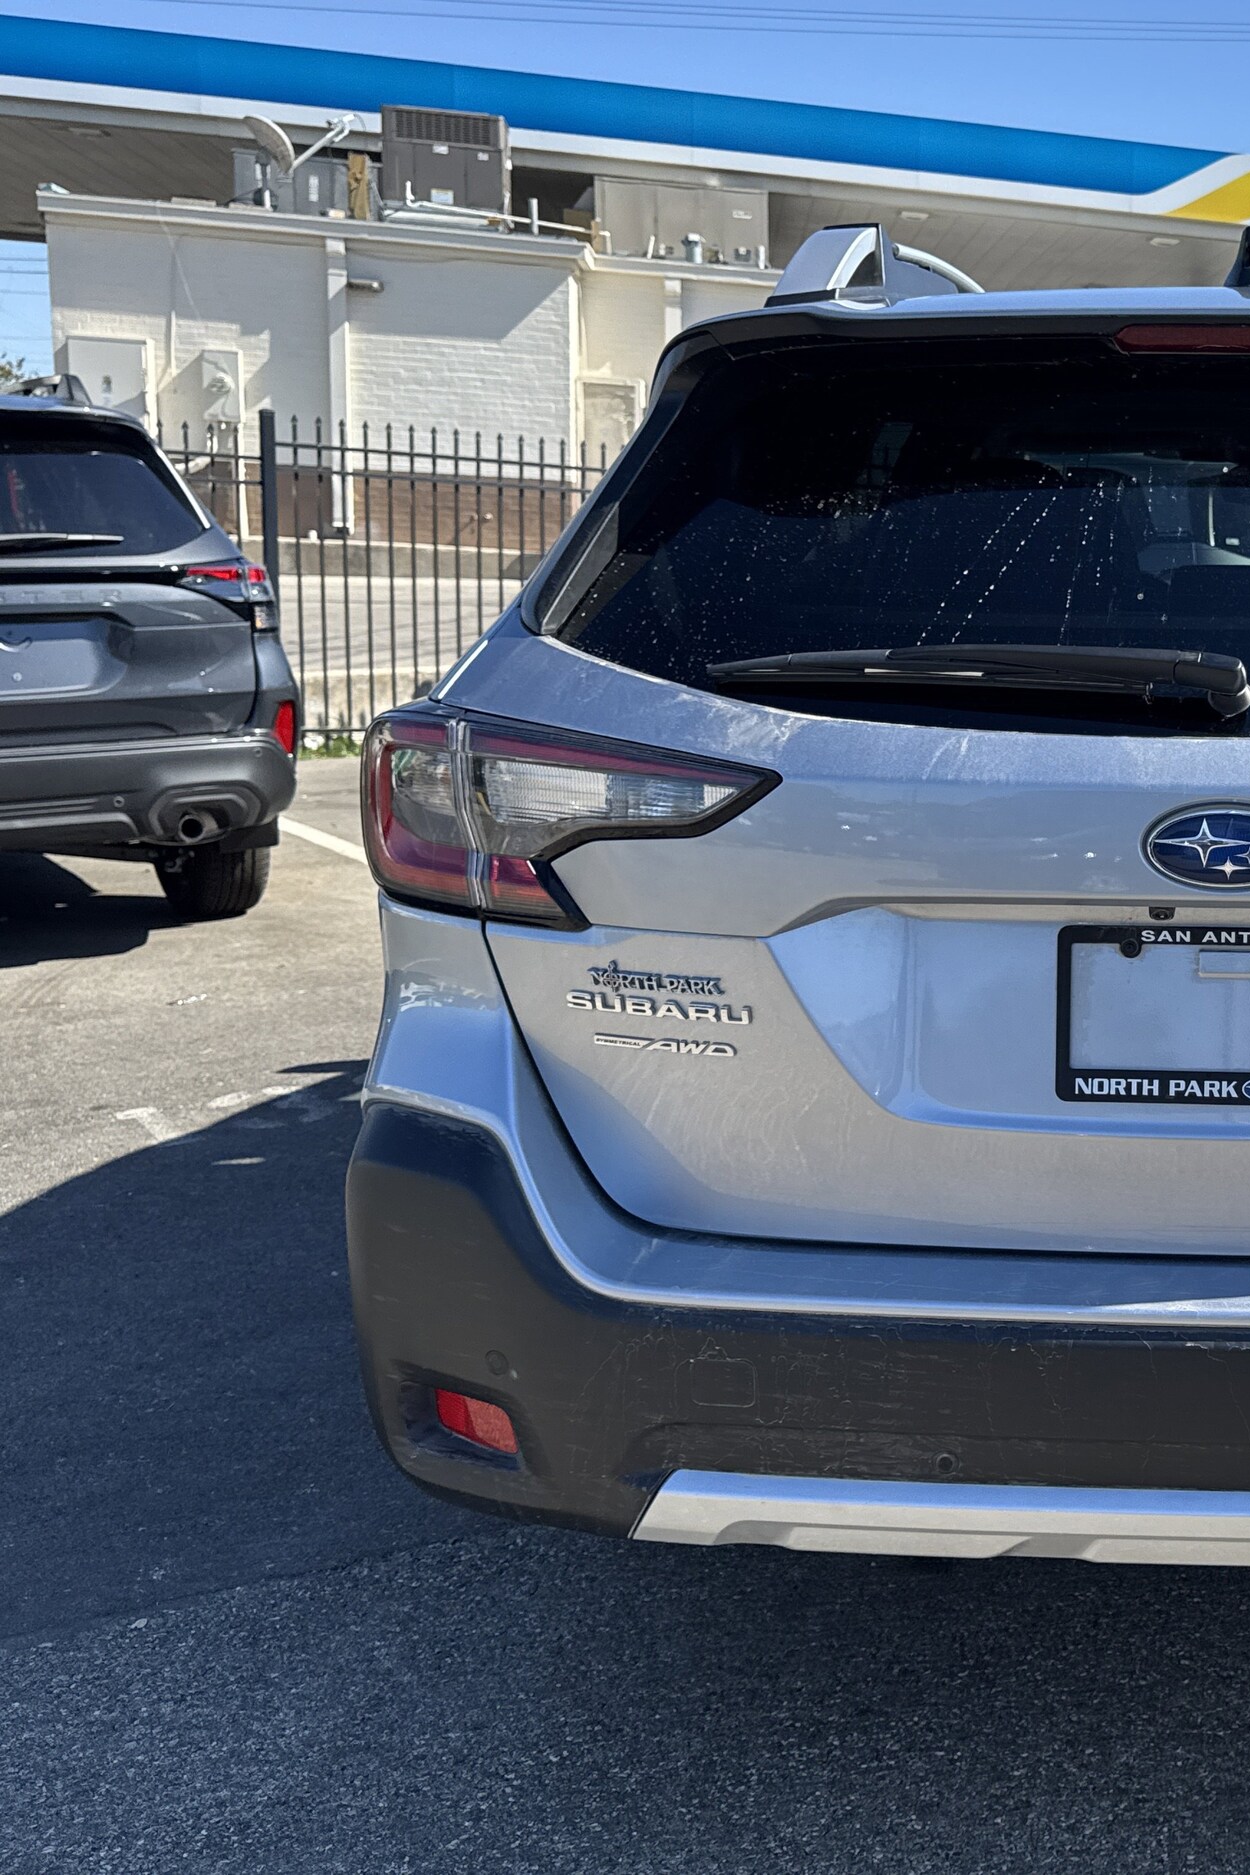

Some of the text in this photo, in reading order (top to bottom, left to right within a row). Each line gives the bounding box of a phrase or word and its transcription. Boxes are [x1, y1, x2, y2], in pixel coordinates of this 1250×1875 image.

[1141, 930, 1191, 943] SAN
[589, 966, 722, 995] NORTH PARK
[566, 990, 751, 1025] SUBARU
[645, 1039, 737, 1057] AWD
[1075, 1078, 1159, 1096] NORTH
[1169, 1079, 1238, 1098] PARK
